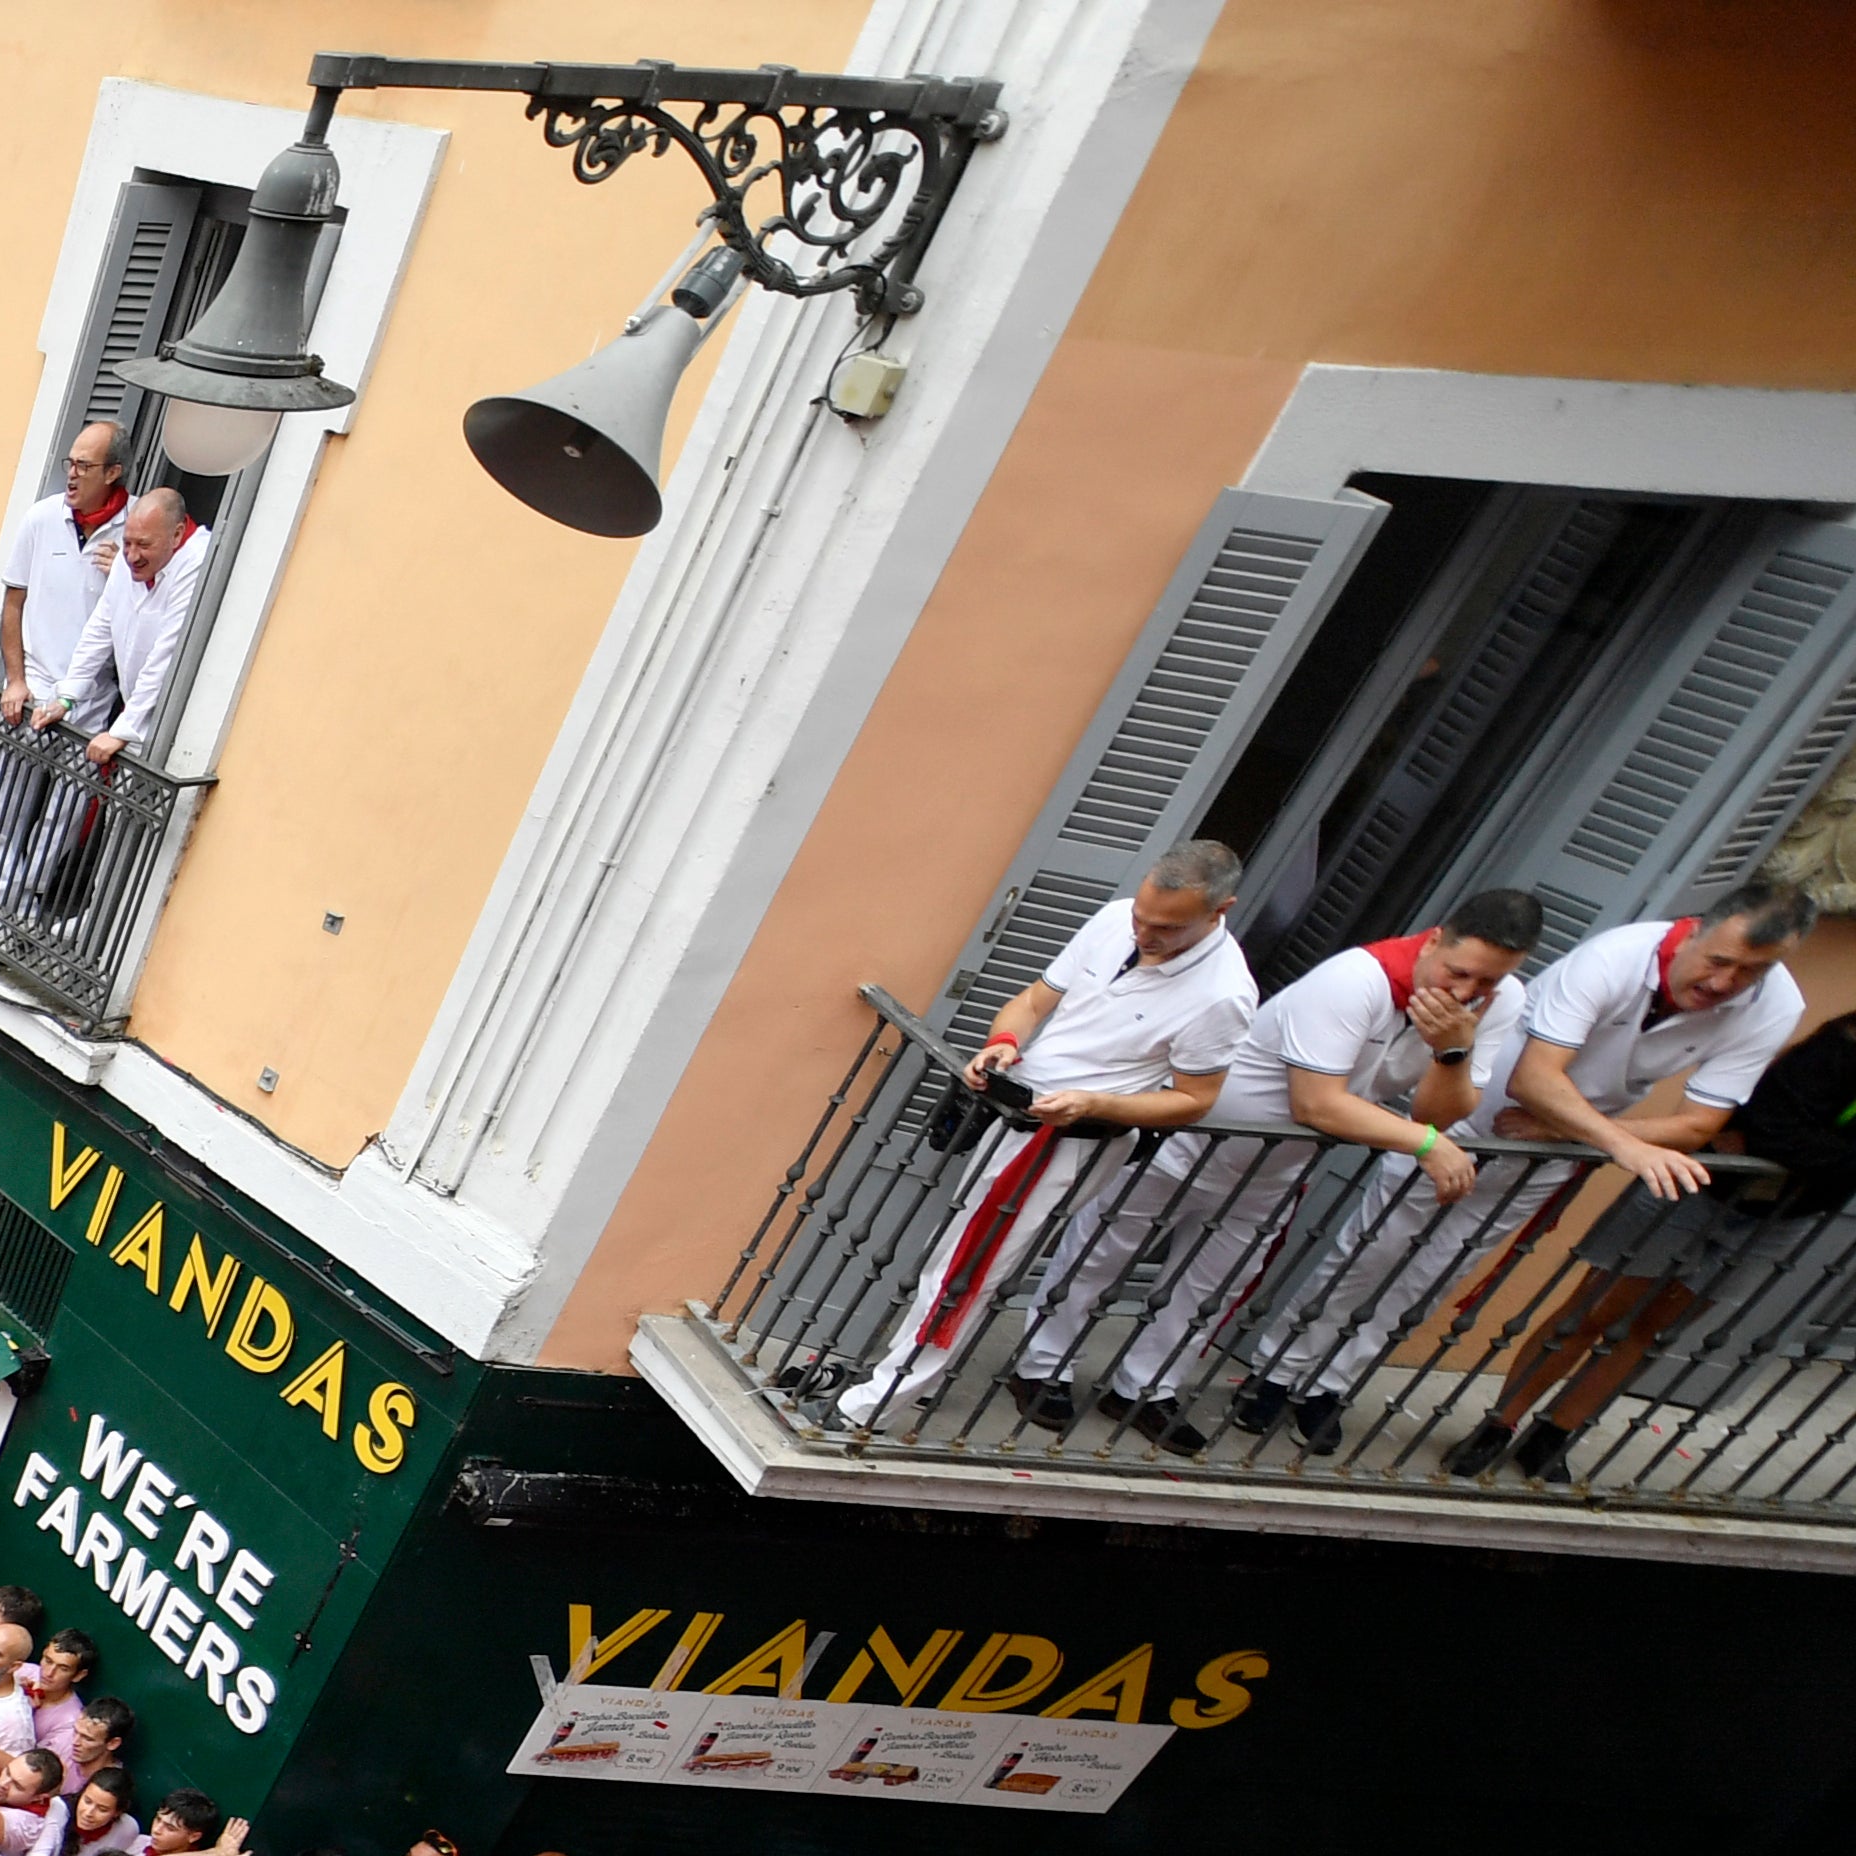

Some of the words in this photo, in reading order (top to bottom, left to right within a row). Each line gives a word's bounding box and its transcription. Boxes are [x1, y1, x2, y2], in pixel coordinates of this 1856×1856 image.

[49, 1120, 417, 1474] VIANDAS
[13, 1452, 278, 1735] FARMERS
[79, 1412, 275, 1631] WE'RE
[568, 1603, 1270, 1730] VIANDAS
